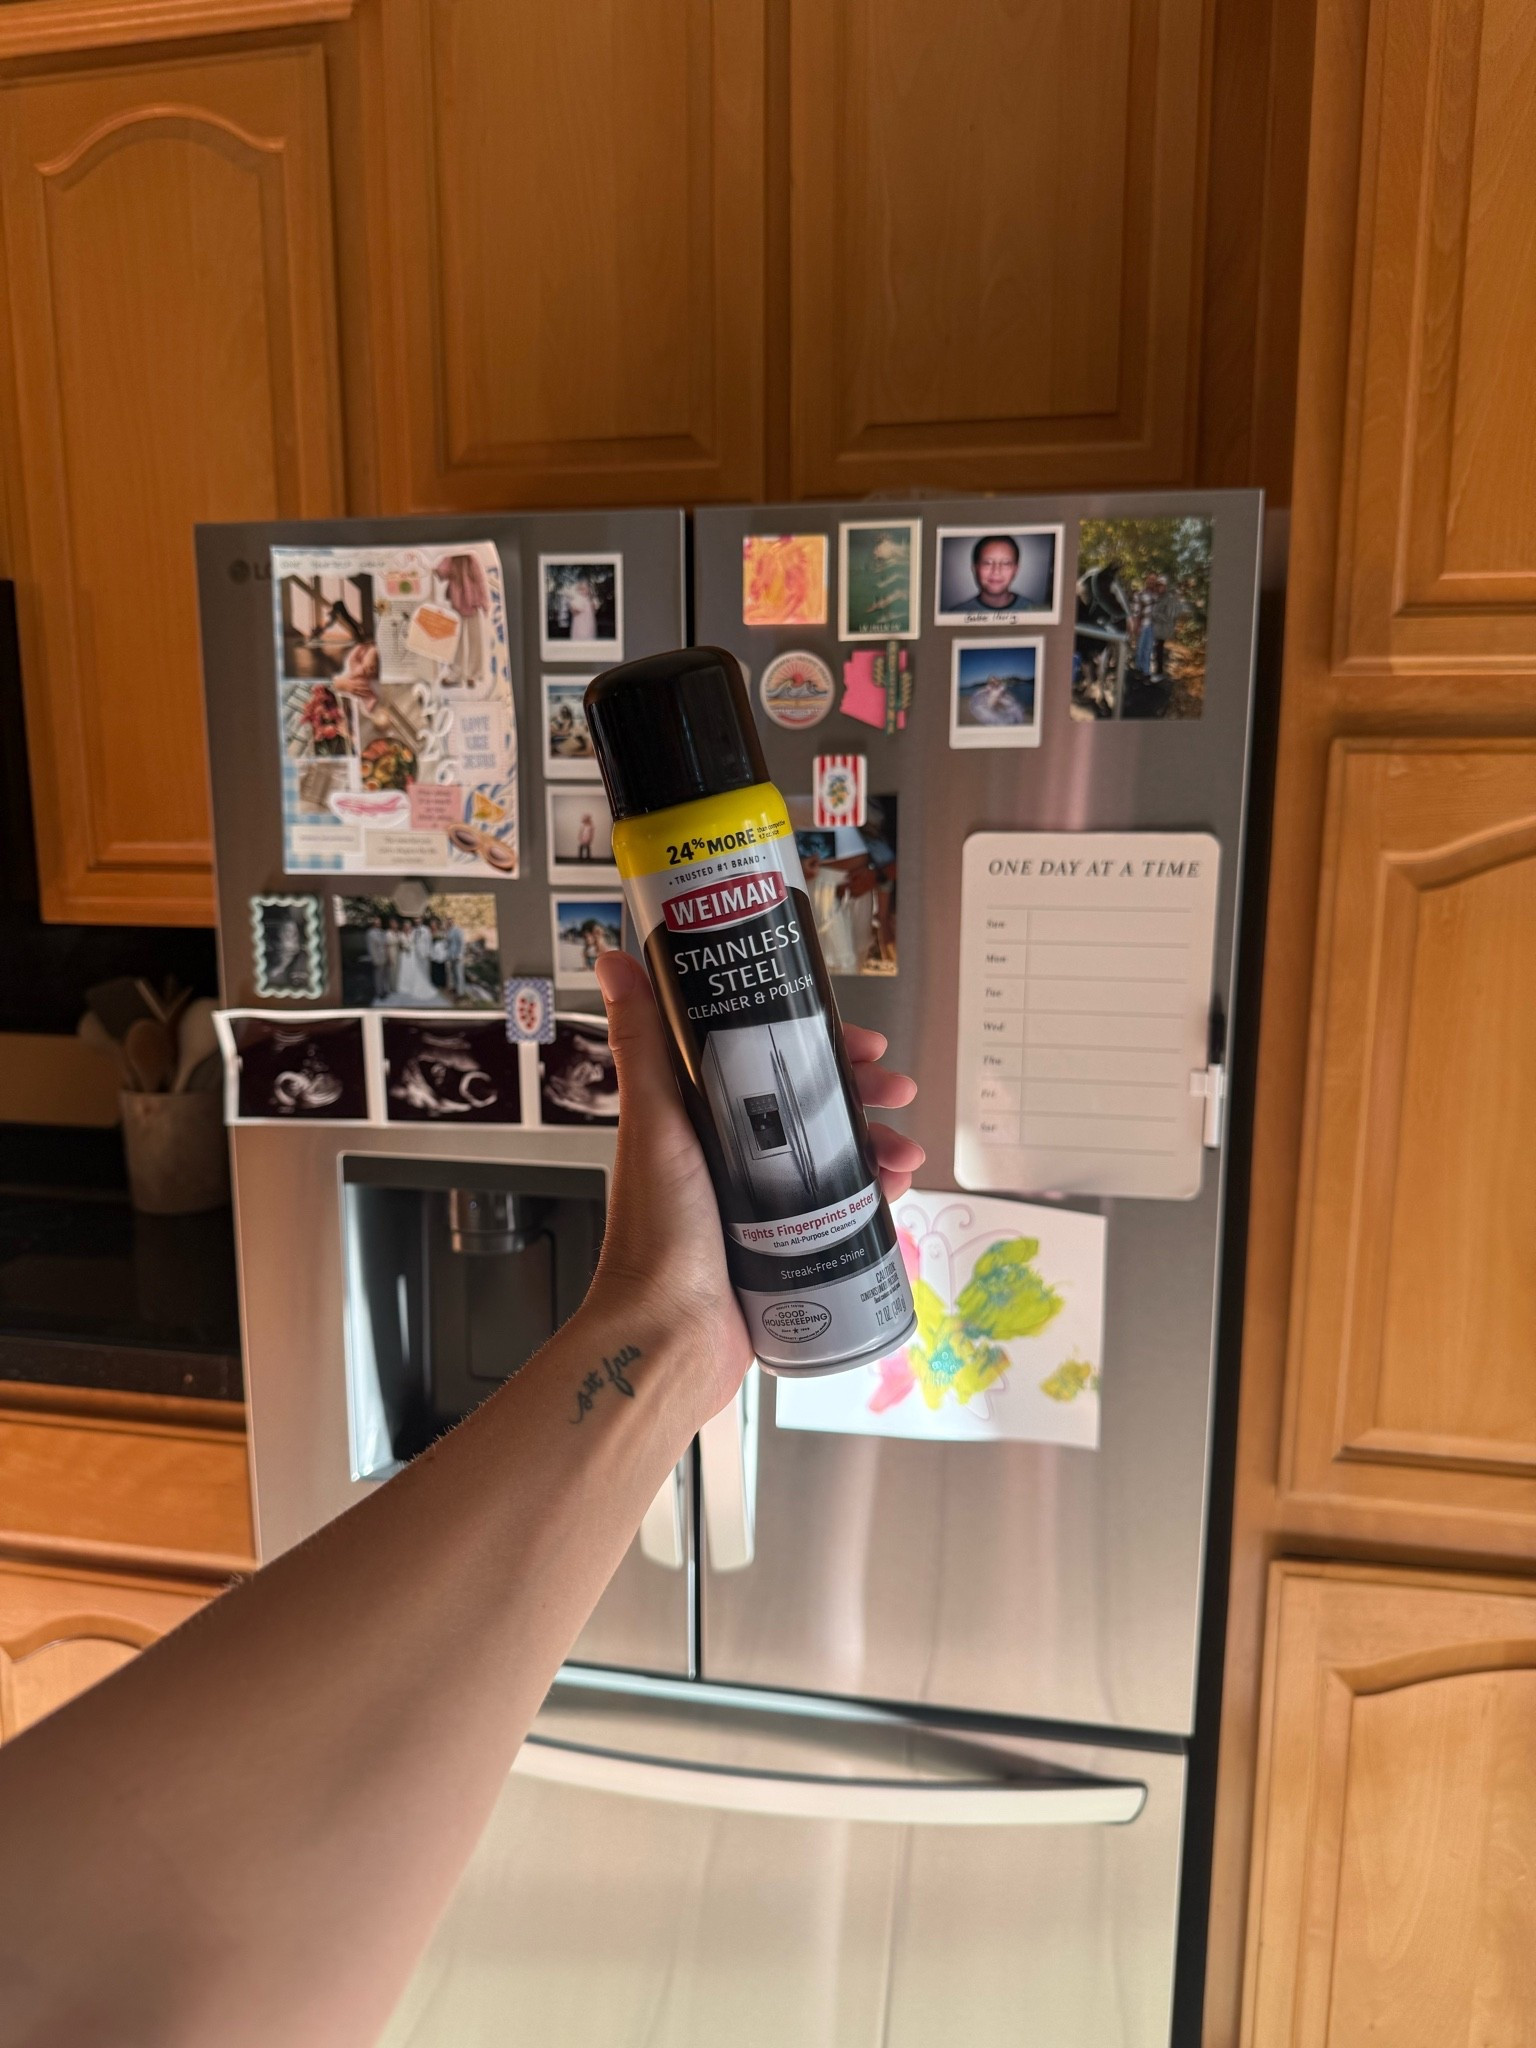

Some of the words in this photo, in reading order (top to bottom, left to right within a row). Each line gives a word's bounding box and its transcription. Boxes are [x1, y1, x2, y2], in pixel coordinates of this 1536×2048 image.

[666, 837, 706, 866] 24%
[706, 828, 757, 855] MORE
[674, 866, 714, 885] TRUSTED
[717, 862, 728, 871] #1
[731, 855, 760, 868] BRAND
[988, 859, 1033, 877] ONE
[1039, 859, 1083, 877] DAY
[1085, 860, 1114, 877] AT
[1118, 860, 1133, 877] A
[1142, 860, 1201, 878] TIME
[670, 876, 778, 926] WEIMAN
[674, 920, 800, 975] STAINLESS
[708, 958, 786, 997] STEEL
[687, 995, 751, 1020] CLEANER
[754, 991, 766, 1005] &
[769, 974, 814, 1001] POLISH
[742, 1228, 775, 1242] Fights
[776, 1208, 848, 1237] Fingerprints
[848, 1192, 875, 1214] Better
[773, 1240, 790, 1248] than
[790, 1229, 830, 1245] All-Purpose
[830, 1218, 857, 1234] Cleaners
[780, 1260, 838, 1280] Streak-Free
[839, 1247, 866, 1265] Shine
[764, 1312, 828, 1327] HOUSEKEEPING
[778, 1309, 805, 1319] GOOD
[875, 1310, 884, 1327] 12
[602, 1344, 642, 1398] free
